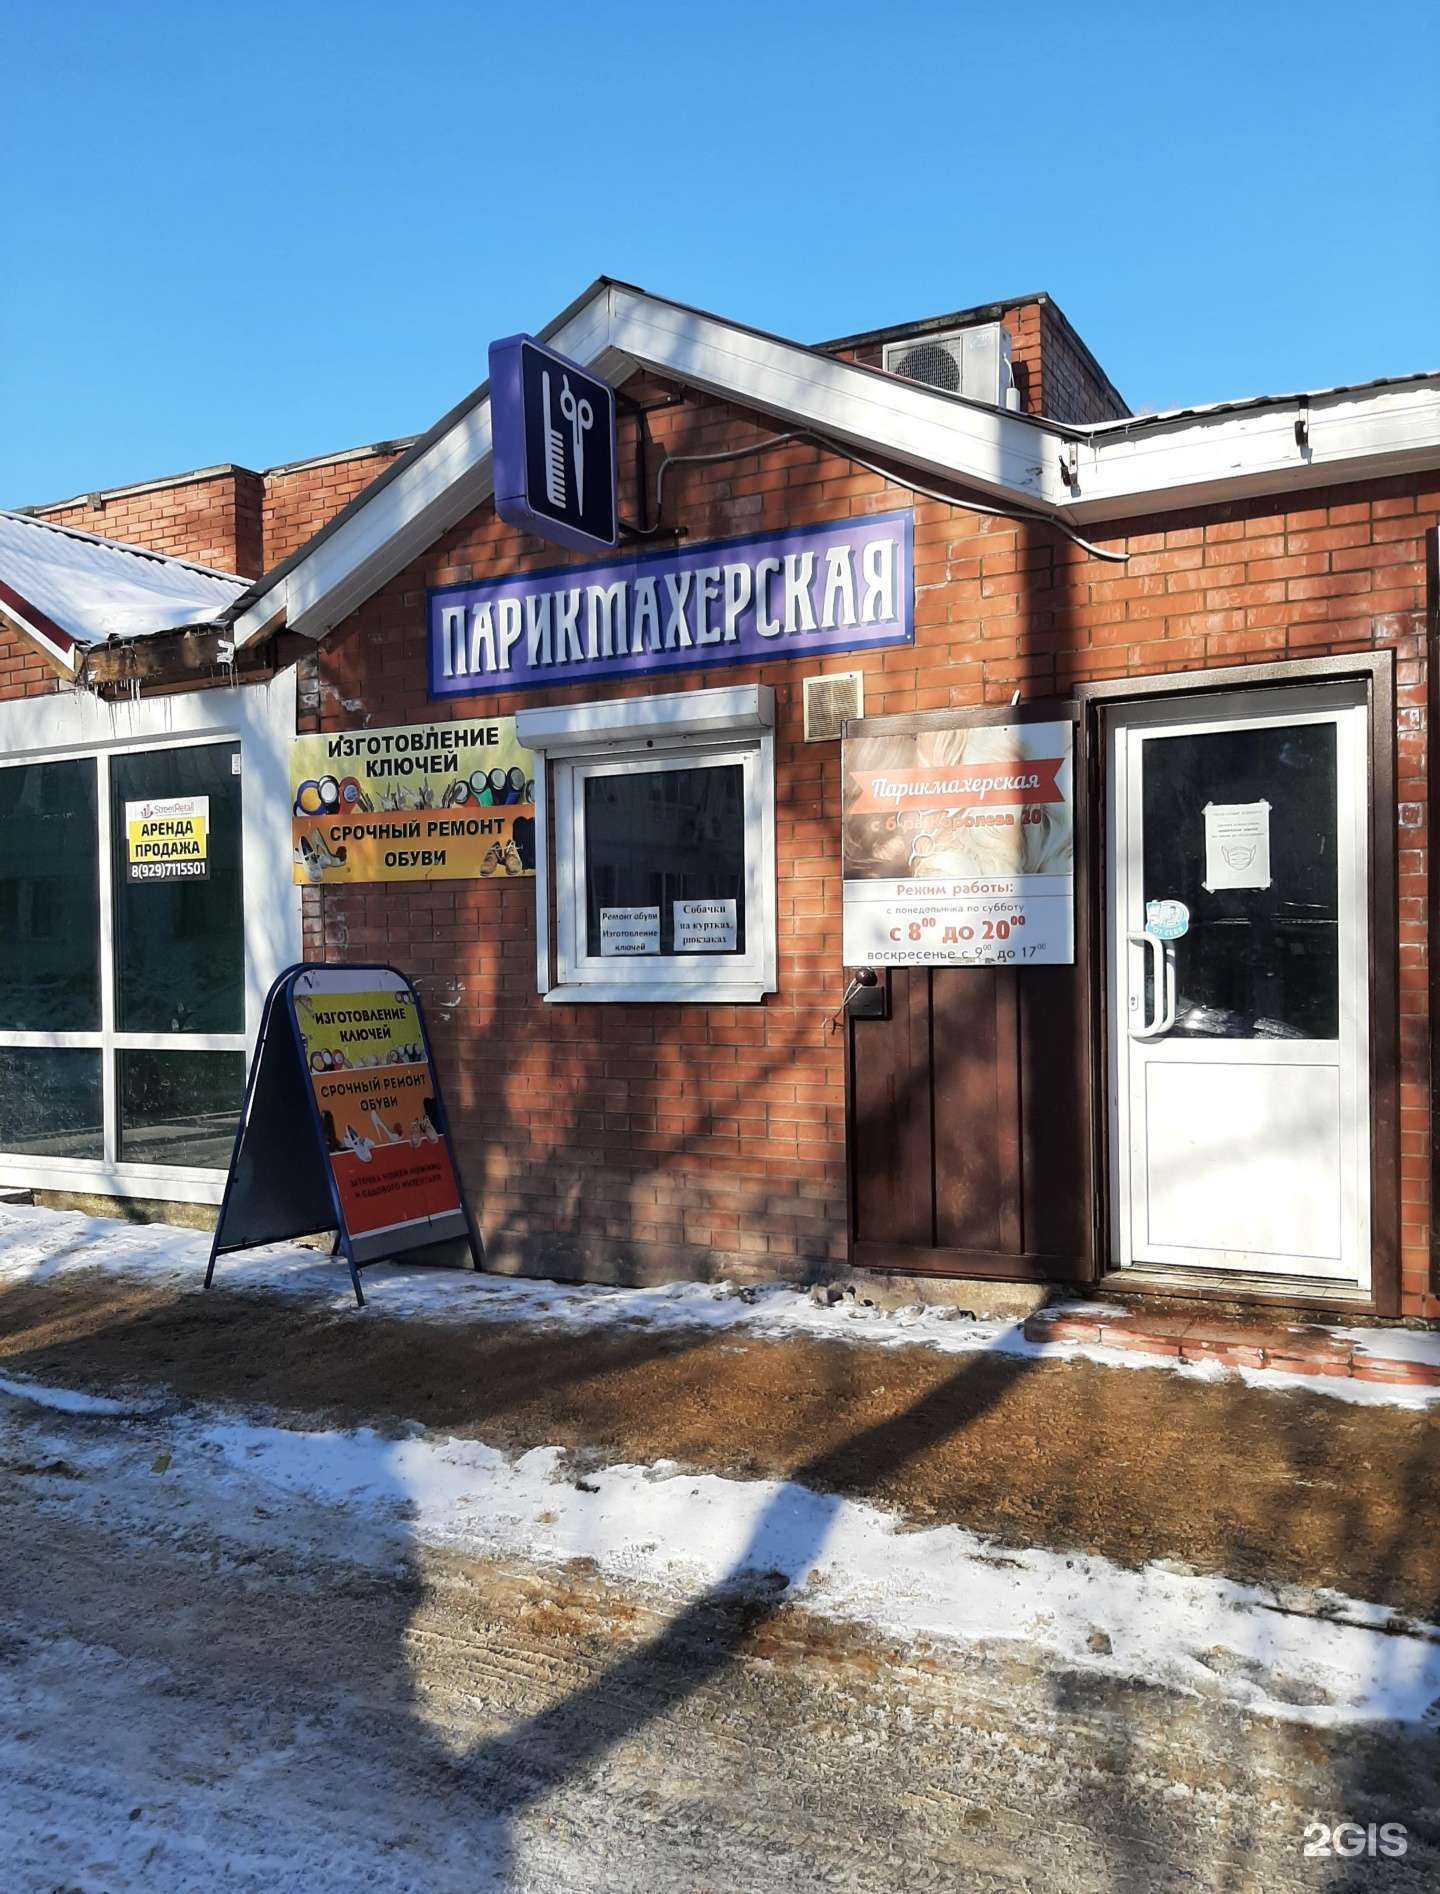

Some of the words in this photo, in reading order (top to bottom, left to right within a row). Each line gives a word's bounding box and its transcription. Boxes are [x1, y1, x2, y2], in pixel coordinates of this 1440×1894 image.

[441, 537, 903, 677] ПАРИКМАХЕРСКАЯ
[328, 727, 499, 757] ИЗГОТОВЛЕНИЕ
[366, 751, 458, 777] КЛЮЧЕЙ
[871, 774, 1040, 805] Парикмахерская
[141, 821, 193, 837] АРЕНДА
[330, 819, 421, 841] СРОЧНЫЙ
[427, 818, 505, 837] РЕМОНТ
[135, 841, 200, 858] ПРОДАЖА
[384, 850, 446, 867] ОБУВИ
[131, 862, 206, 880] 8(929)7115501
[896, 884, 947, 896] Режим
[953, 881, 1015, 897] работы:
[683, 904, 726, 914] Собачки
[895, 905, 963, 915] понедельника
[982, 902, 1025, 913] субботу
[890, 927, 901, 941] с
[942, 926, 975, 944] до
[867, 950, 956, 963] воскресенье
[961, 951, 969, 960] с
[997, 950, 1015, 962] до
[315, 1008, 406, 1025] ИЗГОТОВЛЕНИЕ
[339, 1024, 391, 1042] КЛЮЧЕЙ
[320, 1076, 381, 1098] СРОЧНЫЙ
[383, 1073, 426, 1091] РЕМОНТ
[360, 1096, 398, 1111] ОБУВИ
